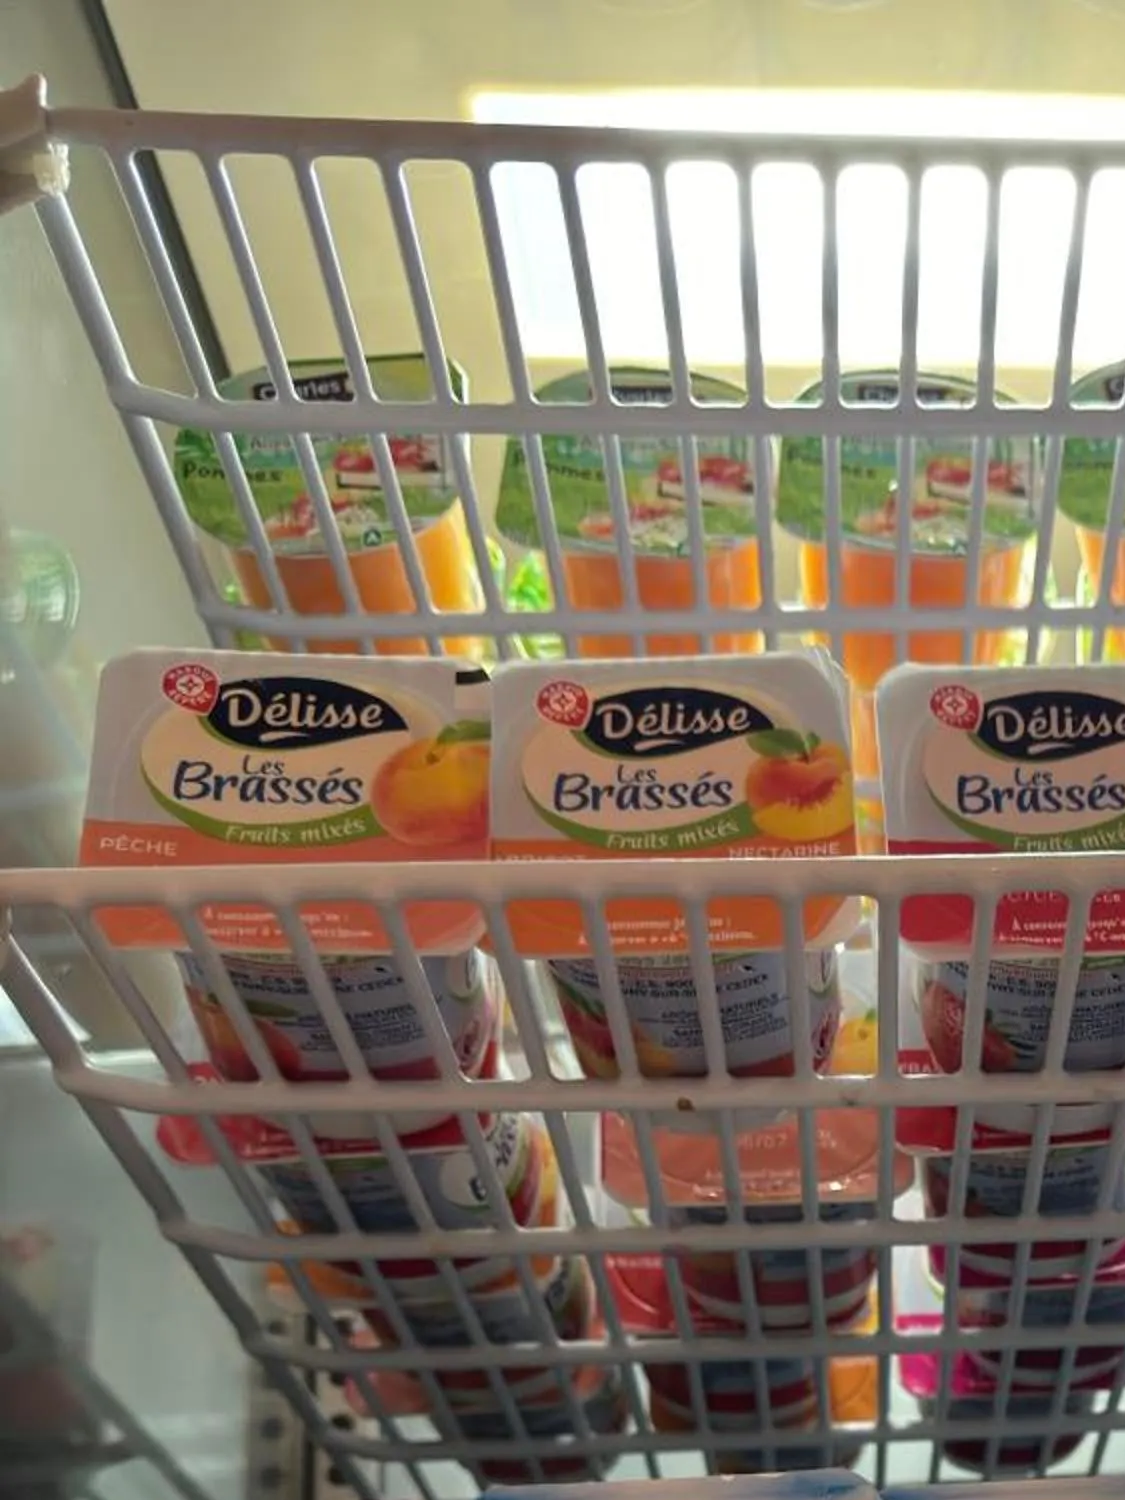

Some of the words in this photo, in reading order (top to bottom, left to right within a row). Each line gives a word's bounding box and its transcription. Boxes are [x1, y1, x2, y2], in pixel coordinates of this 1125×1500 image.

[221, 688, 384, 728] Délisse
[596, 701, 750, 739] Délisse
[242, 755, 285, 776] Les
[617, 764, 657, 783] Les
[1015, 767, 1053, 786] Les
[173, 760, 363, 804] Brassés
[554, 771, 733, 812] Brassés
[225, 824, 291, 843] Fruits
[301, 816, 367, 842] mixés
[606, 830, 669, 850] Fruits
[676, 817, 741, 844] mixés
[100, 833, 178, 857] PÊCHE
